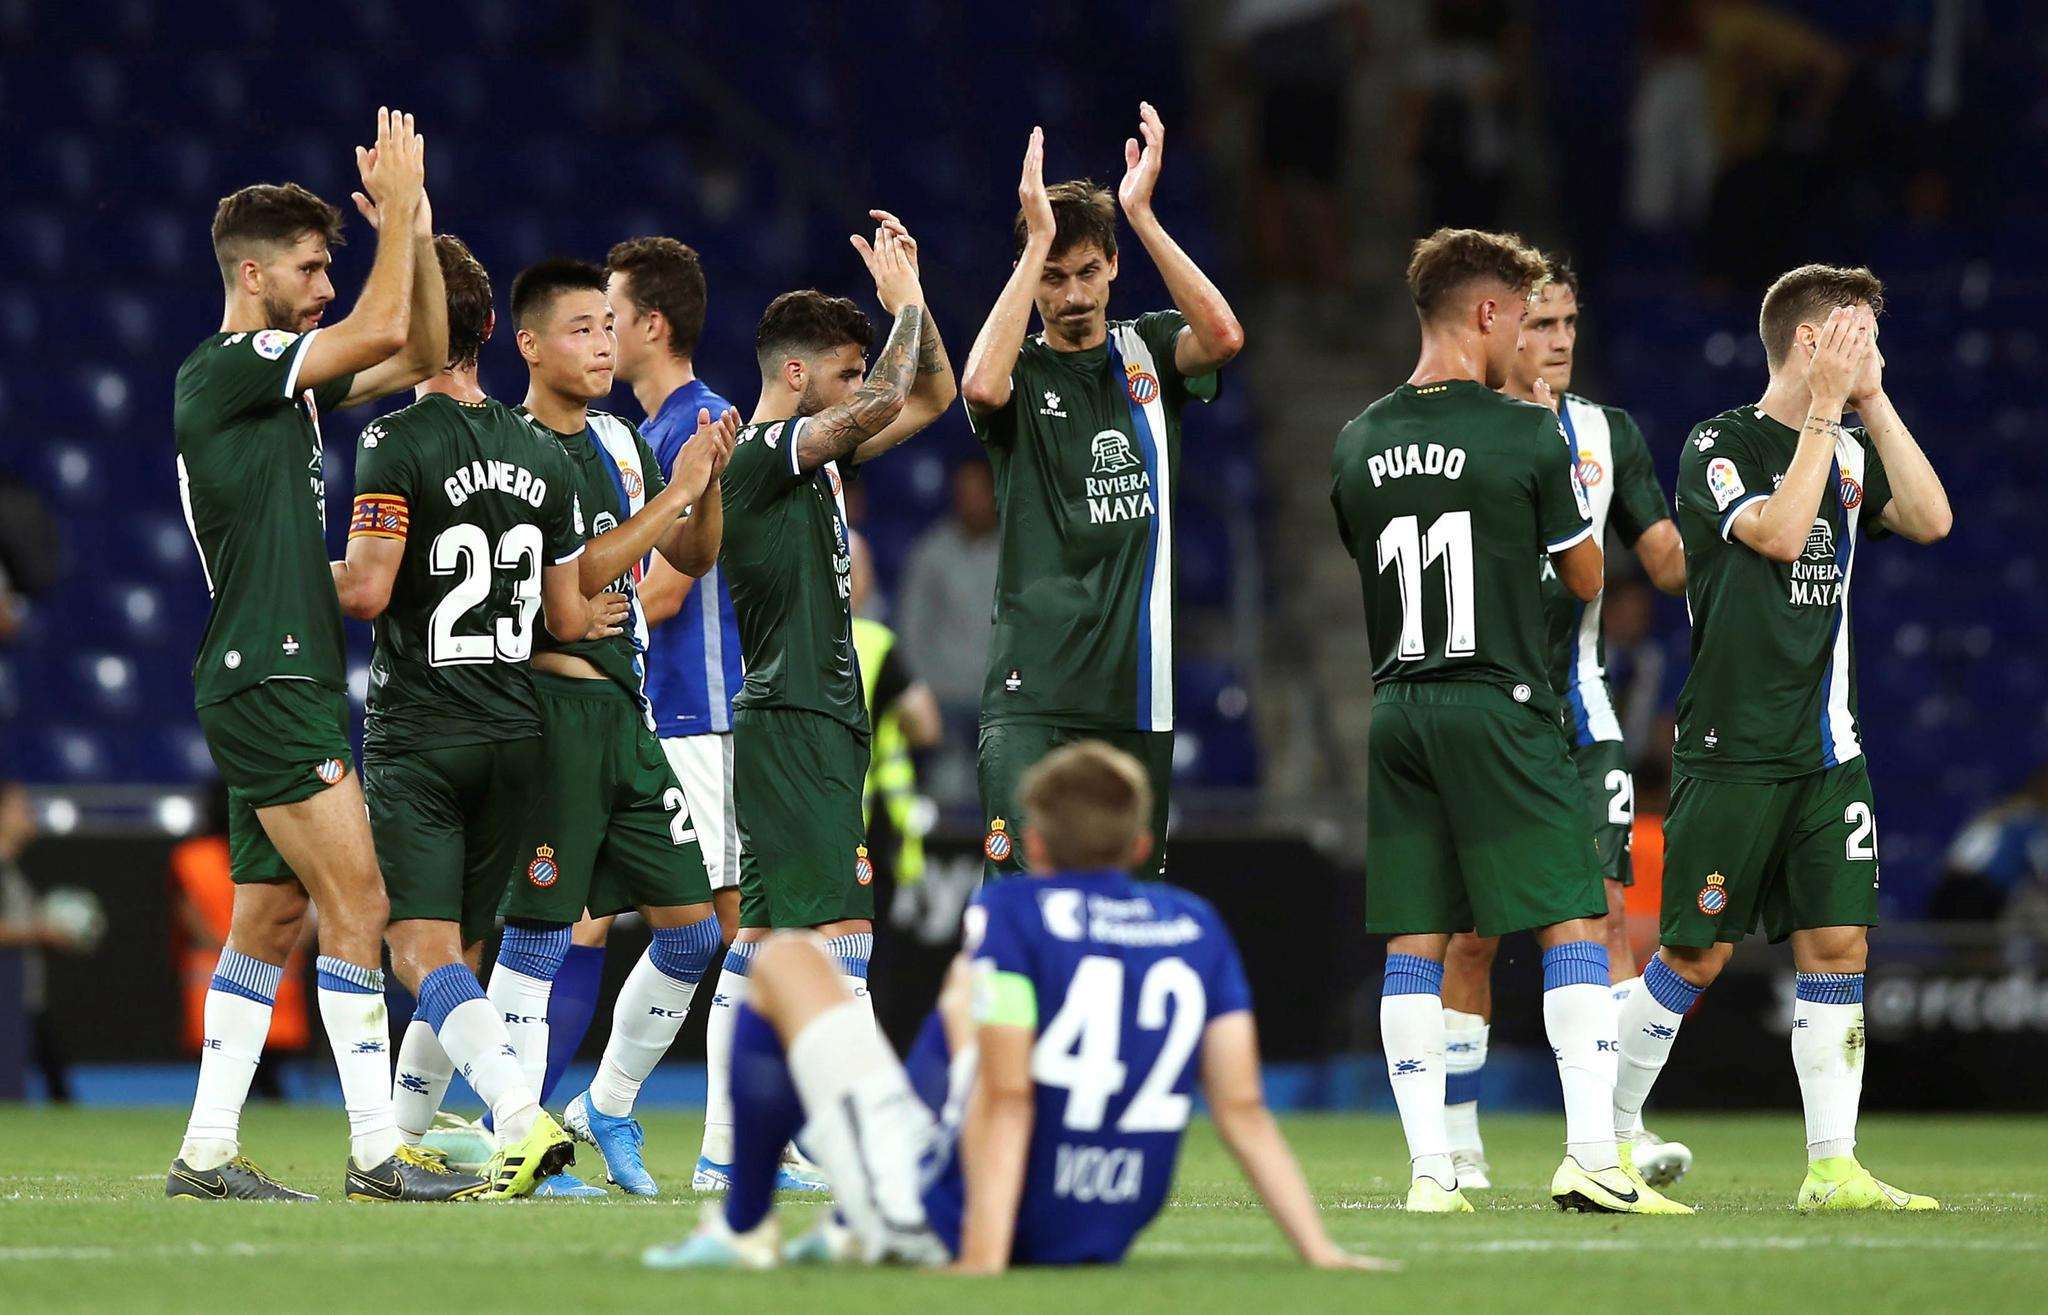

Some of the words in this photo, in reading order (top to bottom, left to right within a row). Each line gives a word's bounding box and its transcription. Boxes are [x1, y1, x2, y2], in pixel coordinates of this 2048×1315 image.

[444, 459, 547, 508] GRANERO
[1085, 471, 1150, 497] RIVIERA
[1367, 443, 1466, 488] PUADO
[1086, 492, 1155, 524] MAYA
[428, 523, 544, 667] 23
[1376, 511, 1476, 661] 11
[1789, 579, 1843, 606] MAYA
[1604, 769, 1634, 824] 2
[1844, 801, 1878, 860] 2
[1031, 955, 1207, 1133] 42
